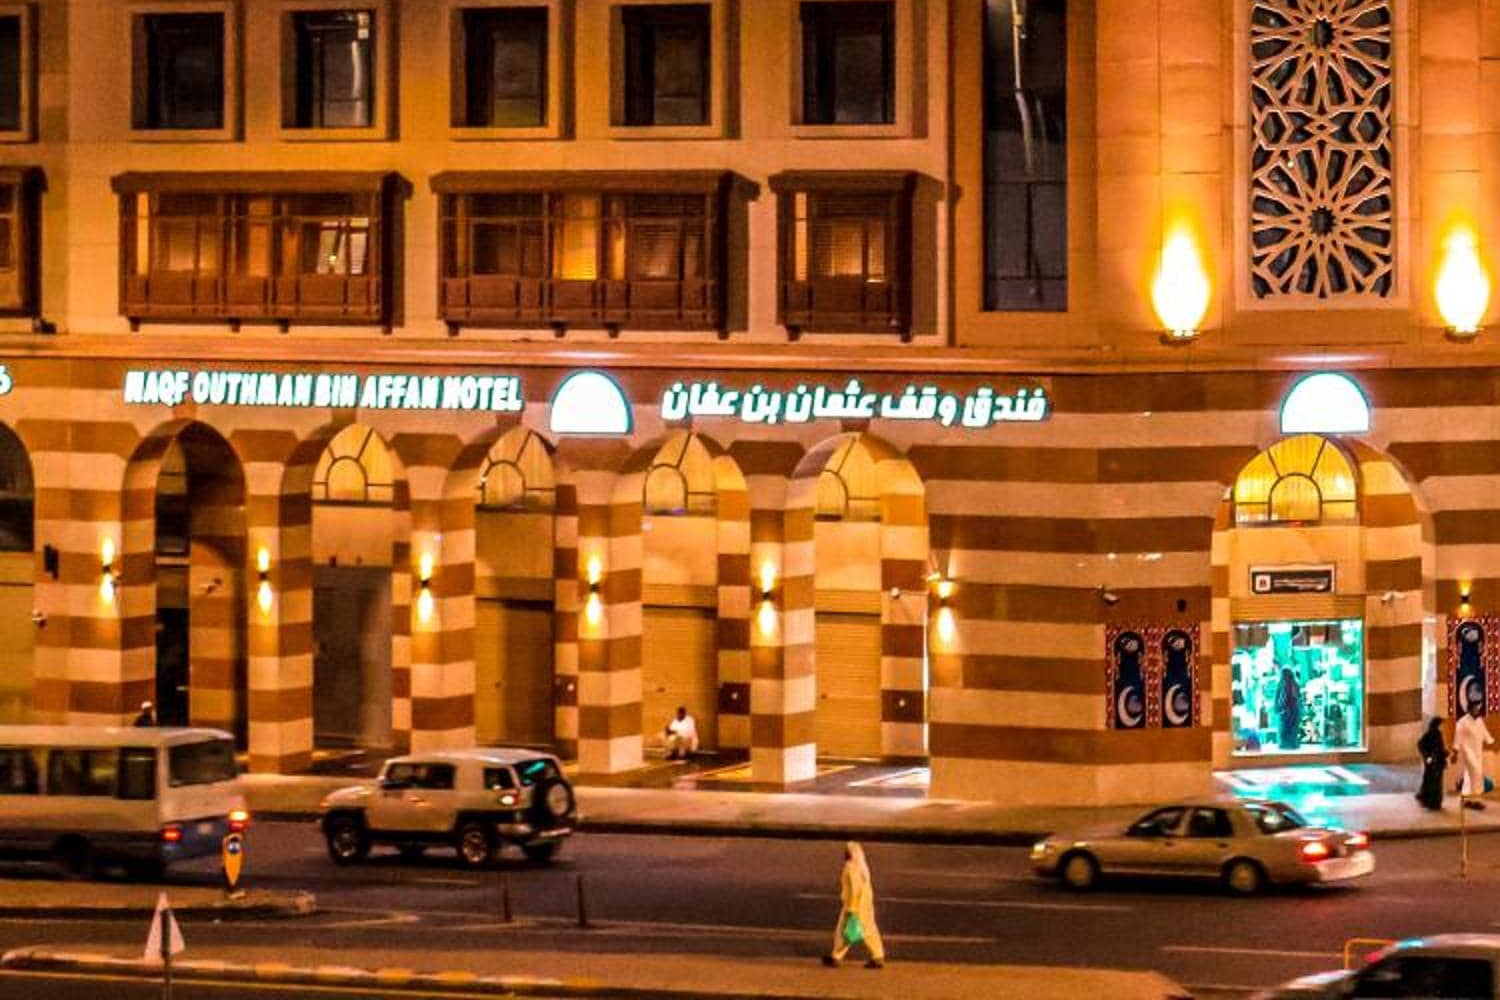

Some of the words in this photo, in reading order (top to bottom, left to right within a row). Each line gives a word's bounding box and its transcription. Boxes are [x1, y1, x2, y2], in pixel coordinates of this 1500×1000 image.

[192, 371, 312, 406] OUTHMAN
[313, 373, 357, 408] BIN
[358, 374, 440, 410] AFFAN
[440, 375, 524, 412] HOTEL
[661, 382, 739, 420] عفان
[741, 384, 782, 424] بن
[785, 379, 877, 423] عثمان
[880, 385, 957, 427] وقف
[961, 387, 1046, 427] فندق
